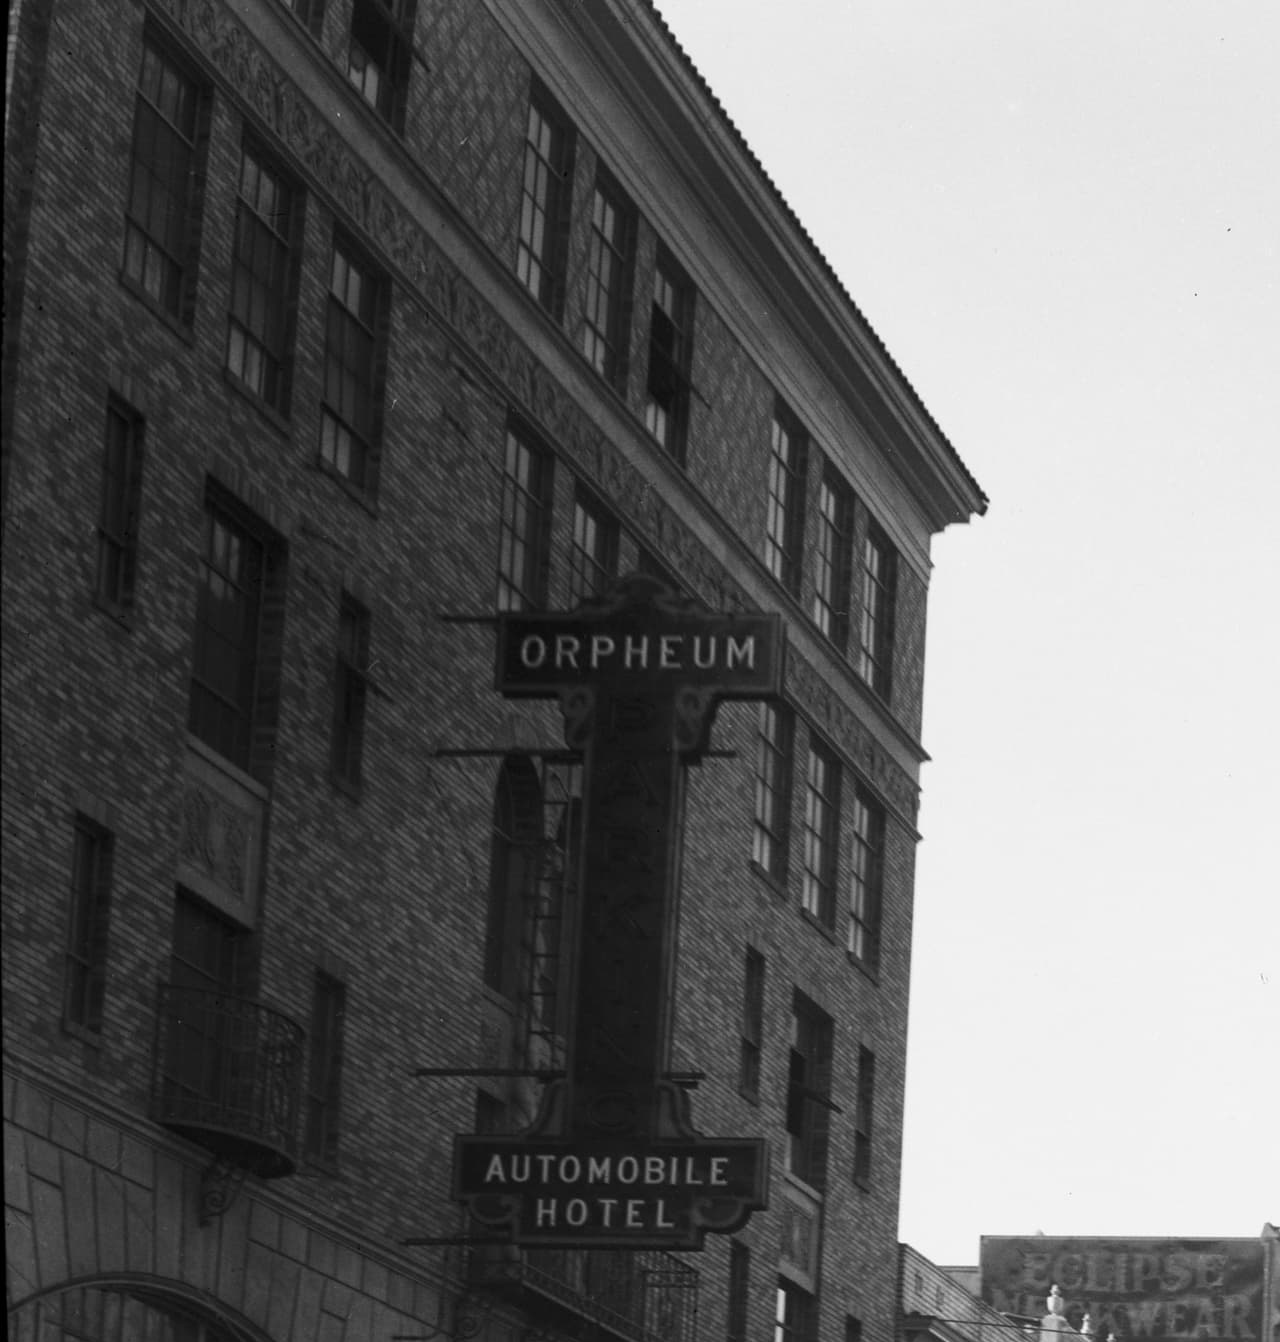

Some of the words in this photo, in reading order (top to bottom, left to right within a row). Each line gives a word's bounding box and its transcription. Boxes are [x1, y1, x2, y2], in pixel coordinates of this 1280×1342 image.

[520, 635, 755, 670] ORPHEUM
[485, 1153, 729, 1185] AUTOMOBILE
[536, 1197, 675, 1228] HOTEL
[1020, 1251, 1228, 1292] ECLIPSE
